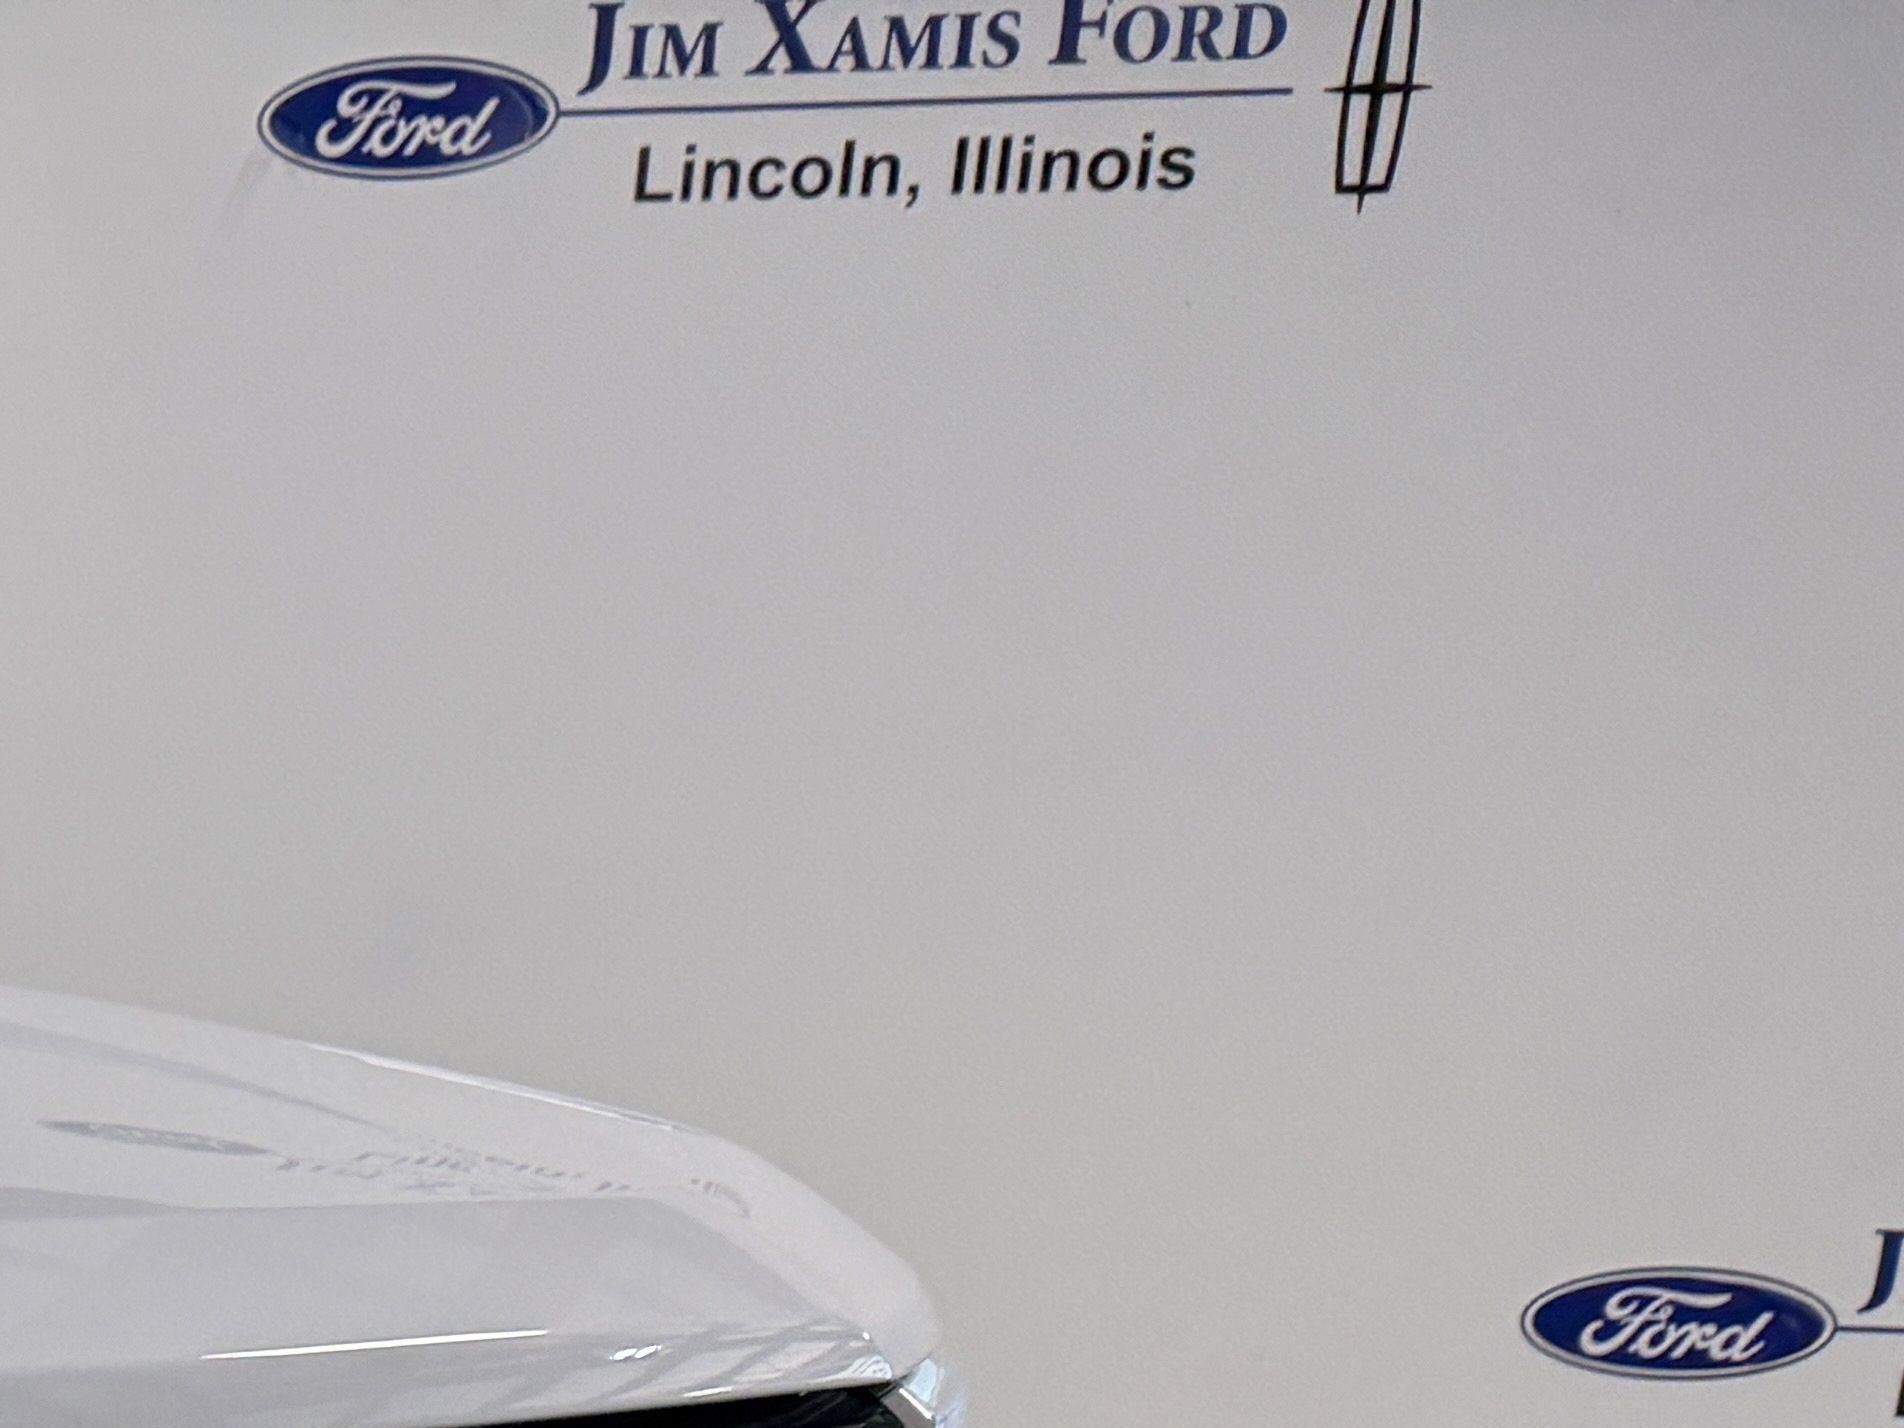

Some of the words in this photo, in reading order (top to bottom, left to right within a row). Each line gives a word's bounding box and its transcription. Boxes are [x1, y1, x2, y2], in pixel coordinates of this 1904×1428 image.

[577, 1, 724, 95] JIM
[745, 0, 1022, 75] XAMIS
[1049, 0, 1288, 64] FORD
[315, 80, 502, 159] Ford
[634, 139, 920, 208] Lincoln,
[951, 131, 1196, 194] Illinois
[1579, 1285, 1774, 1362] Ford
